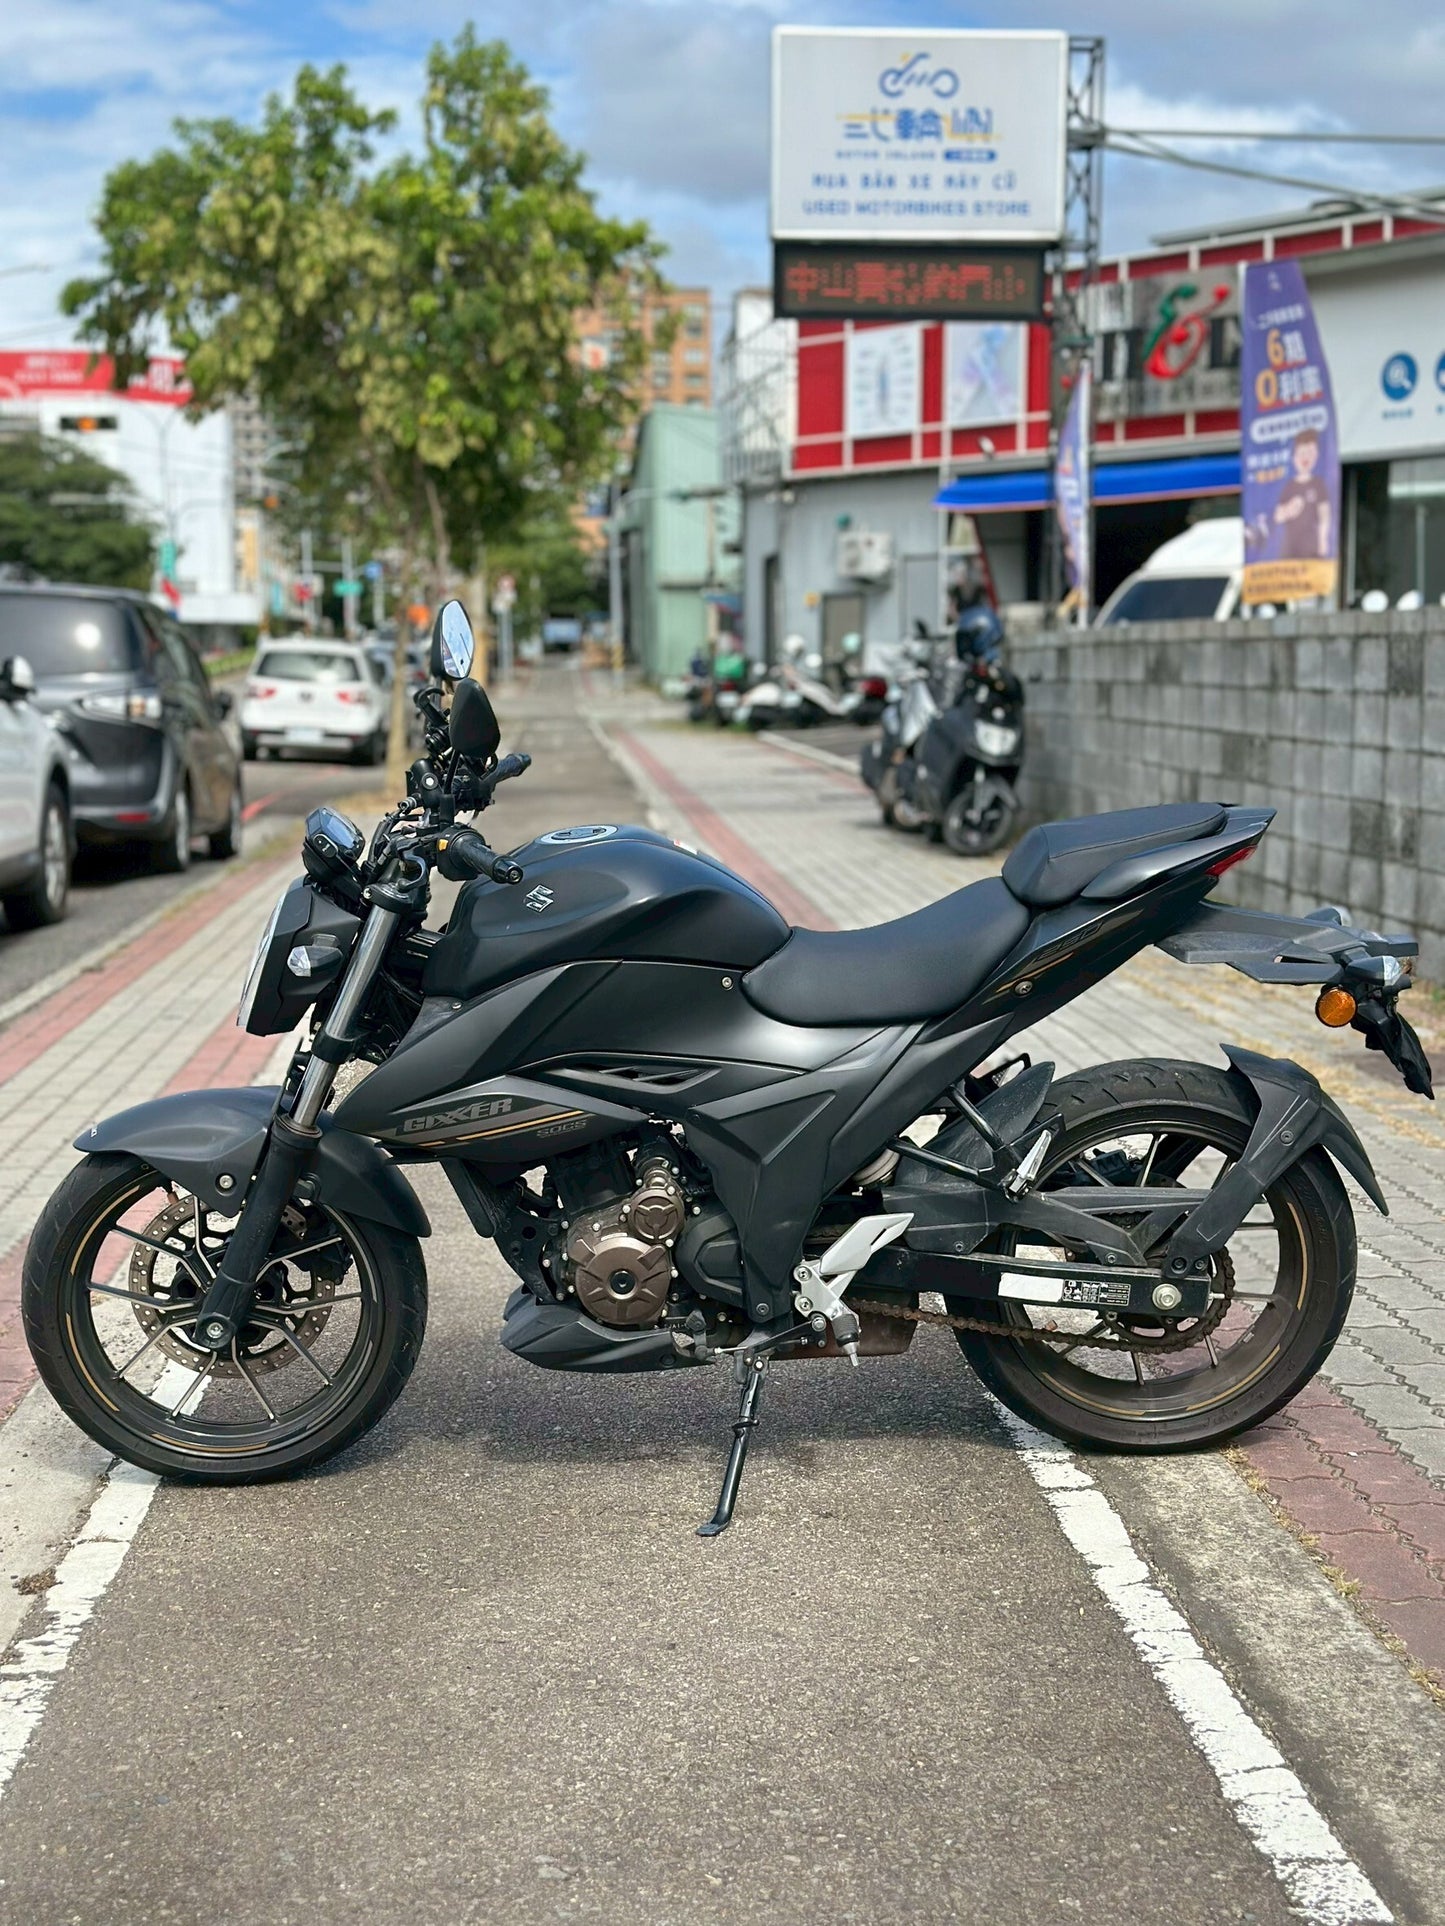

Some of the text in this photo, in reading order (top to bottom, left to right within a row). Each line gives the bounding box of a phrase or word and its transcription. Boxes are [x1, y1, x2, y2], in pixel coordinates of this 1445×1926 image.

[812, 173, 848, 190] MUA
[909, 174, 932, 190] XE
[802, 201, 1031, 217] USED MOTORBIKES STORE
[403, 1097, 513, 1133] GIXXER
[536, 1119, 587, 1136] SOCS
